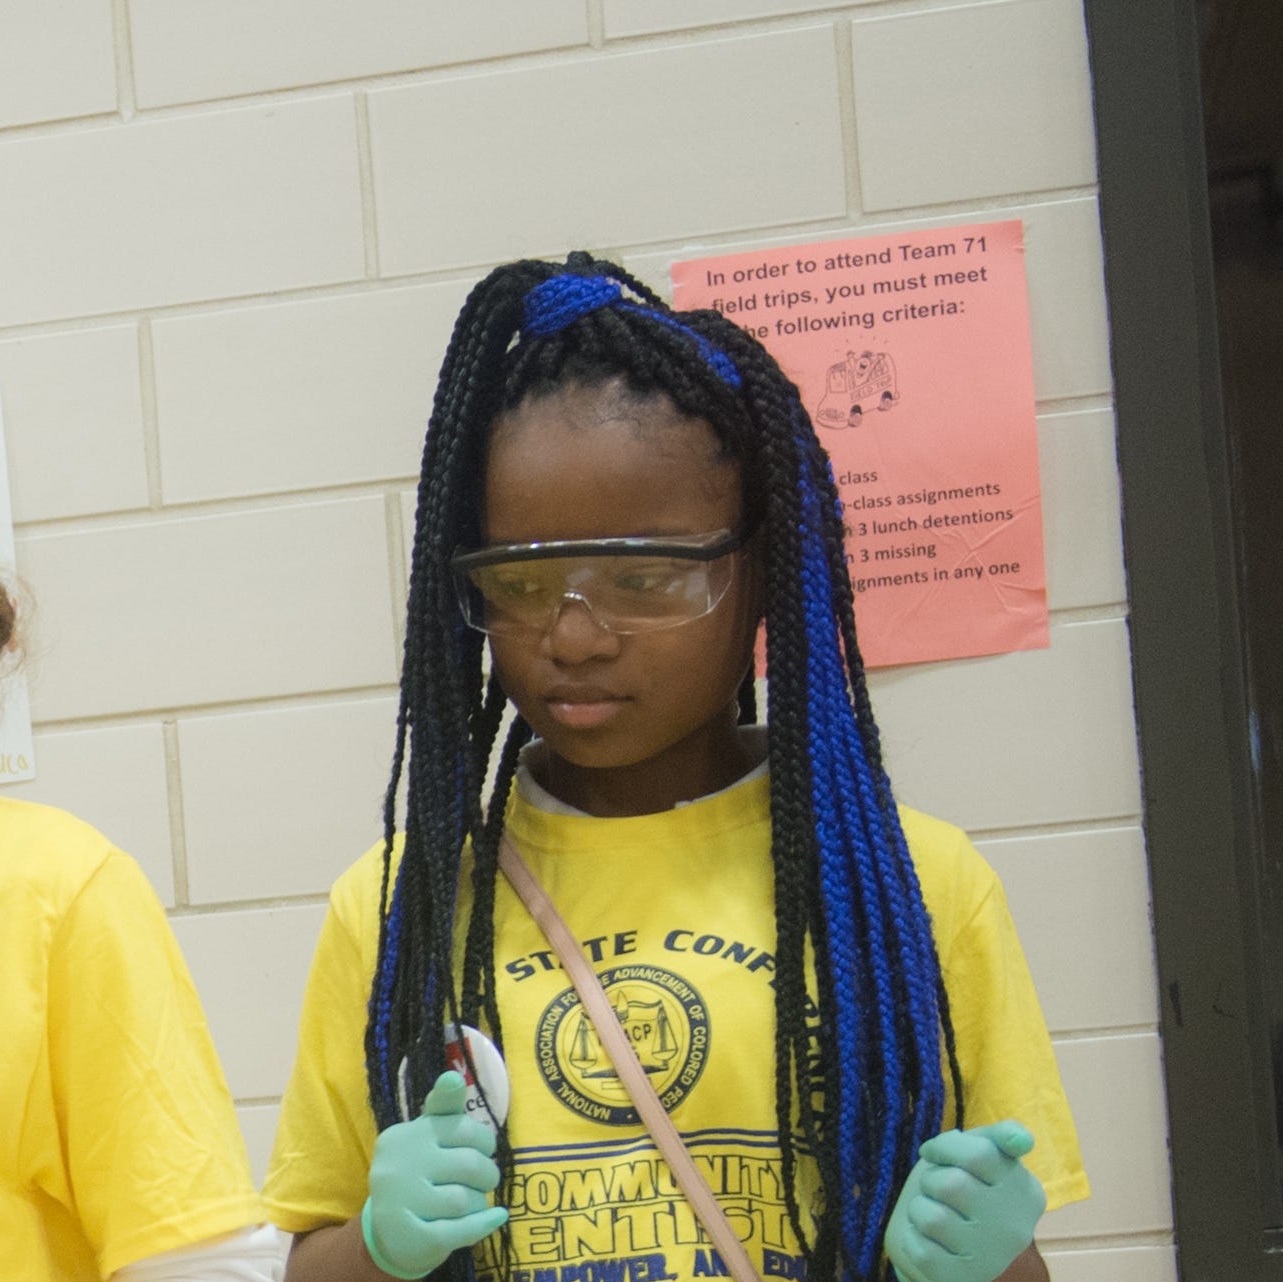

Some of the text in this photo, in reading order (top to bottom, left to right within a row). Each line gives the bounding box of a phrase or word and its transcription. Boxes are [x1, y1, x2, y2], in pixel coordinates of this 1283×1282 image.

[706, 236, 987, 287] In order to attend Team 71
[712, 266, 988, 316] field trips, you must meet
[744, 299, 965, 341] he following criteria:
[839, 470, 878, 486] class
[897, 482, 1001, 505] assignments
[858, 523, 868, 536] 3
[872, 517, 918, 535] lunch
[922, 508, 1014, 529] detentions
[860, 549, 870, 562] 3
[874, 543, 937, 562] missing
[851, 561, 1021, 593] ignments in any one
[505, 930, 638, 982] STTE
[560, 992, 579, 1008] FO
[613, 967, 697, 1003] ADVANCEMENT
[689, 1004, 706, 1022] OF
[539, 1006, 565, 1082] ASSOCIATION
[680, 1026, 707, 1087] COLORED
[558, 1081, 612, 1121] NATIONAL
[511, 1199, 797, 1265] ENTIST
[693, 1248, 731, 1278] AN
